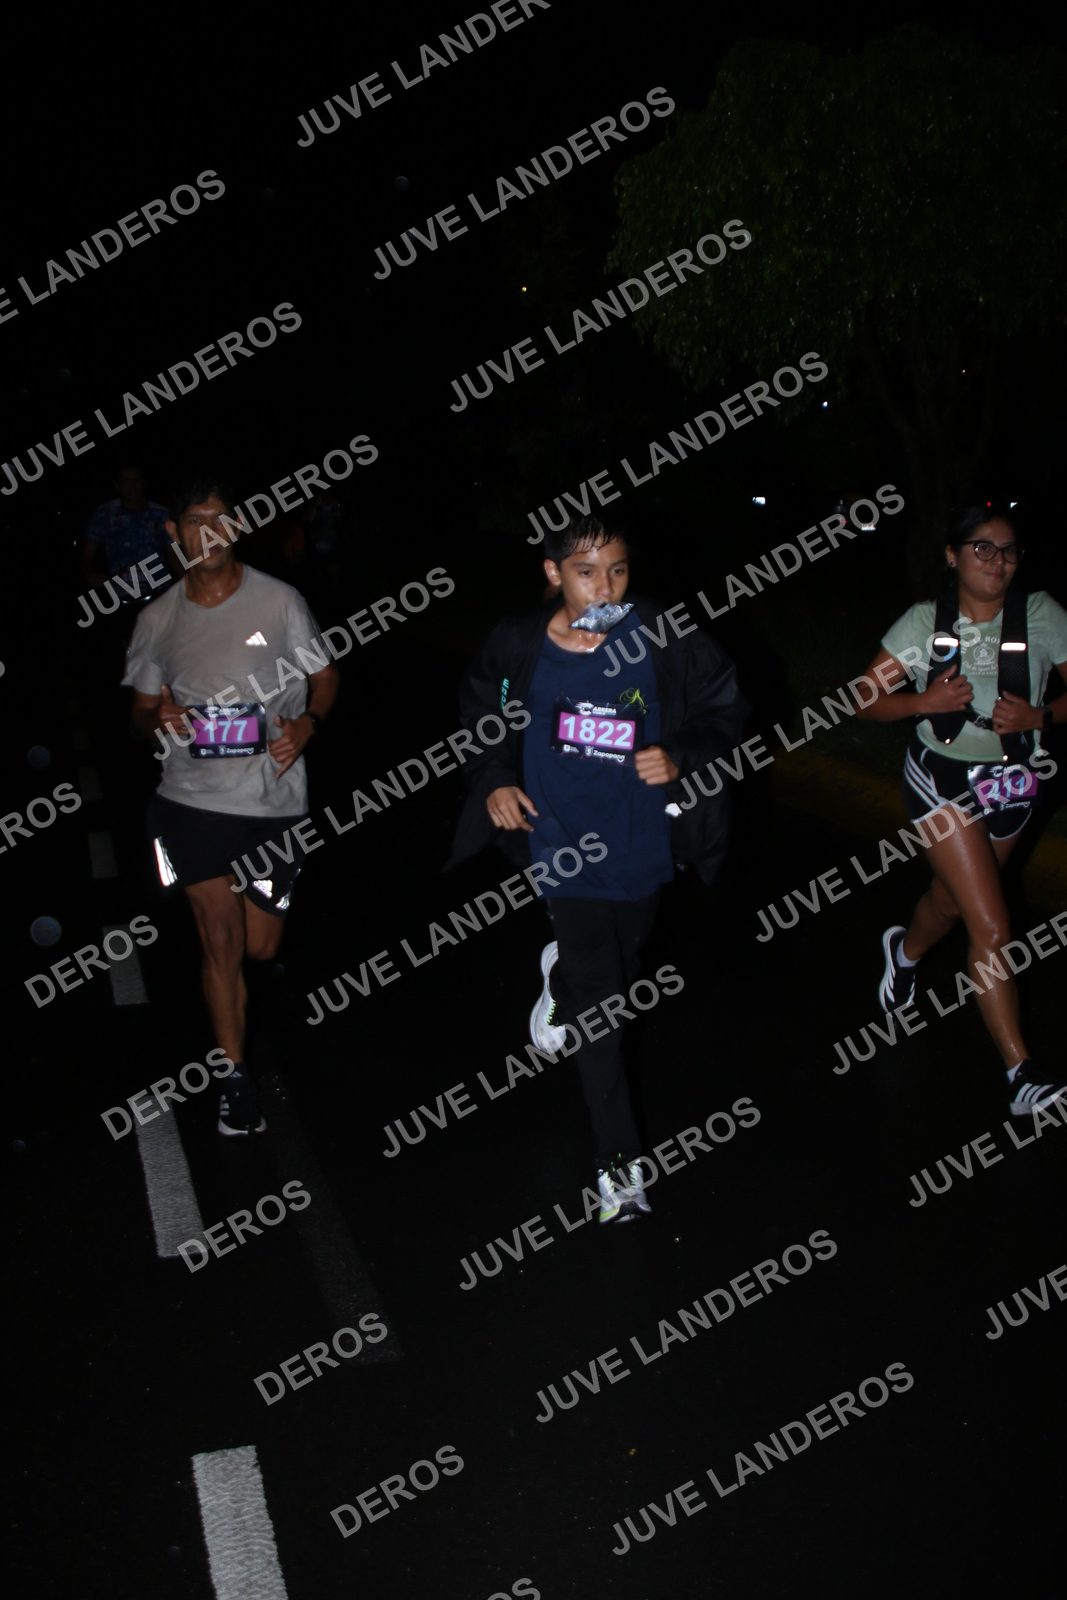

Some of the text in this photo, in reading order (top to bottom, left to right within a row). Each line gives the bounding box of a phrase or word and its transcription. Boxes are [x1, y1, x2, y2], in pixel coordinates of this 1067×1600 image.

[204, 719, 248, 742] 177
[563, 715, 633, 747] 1822
[986, 775, 1026, 800] 411
